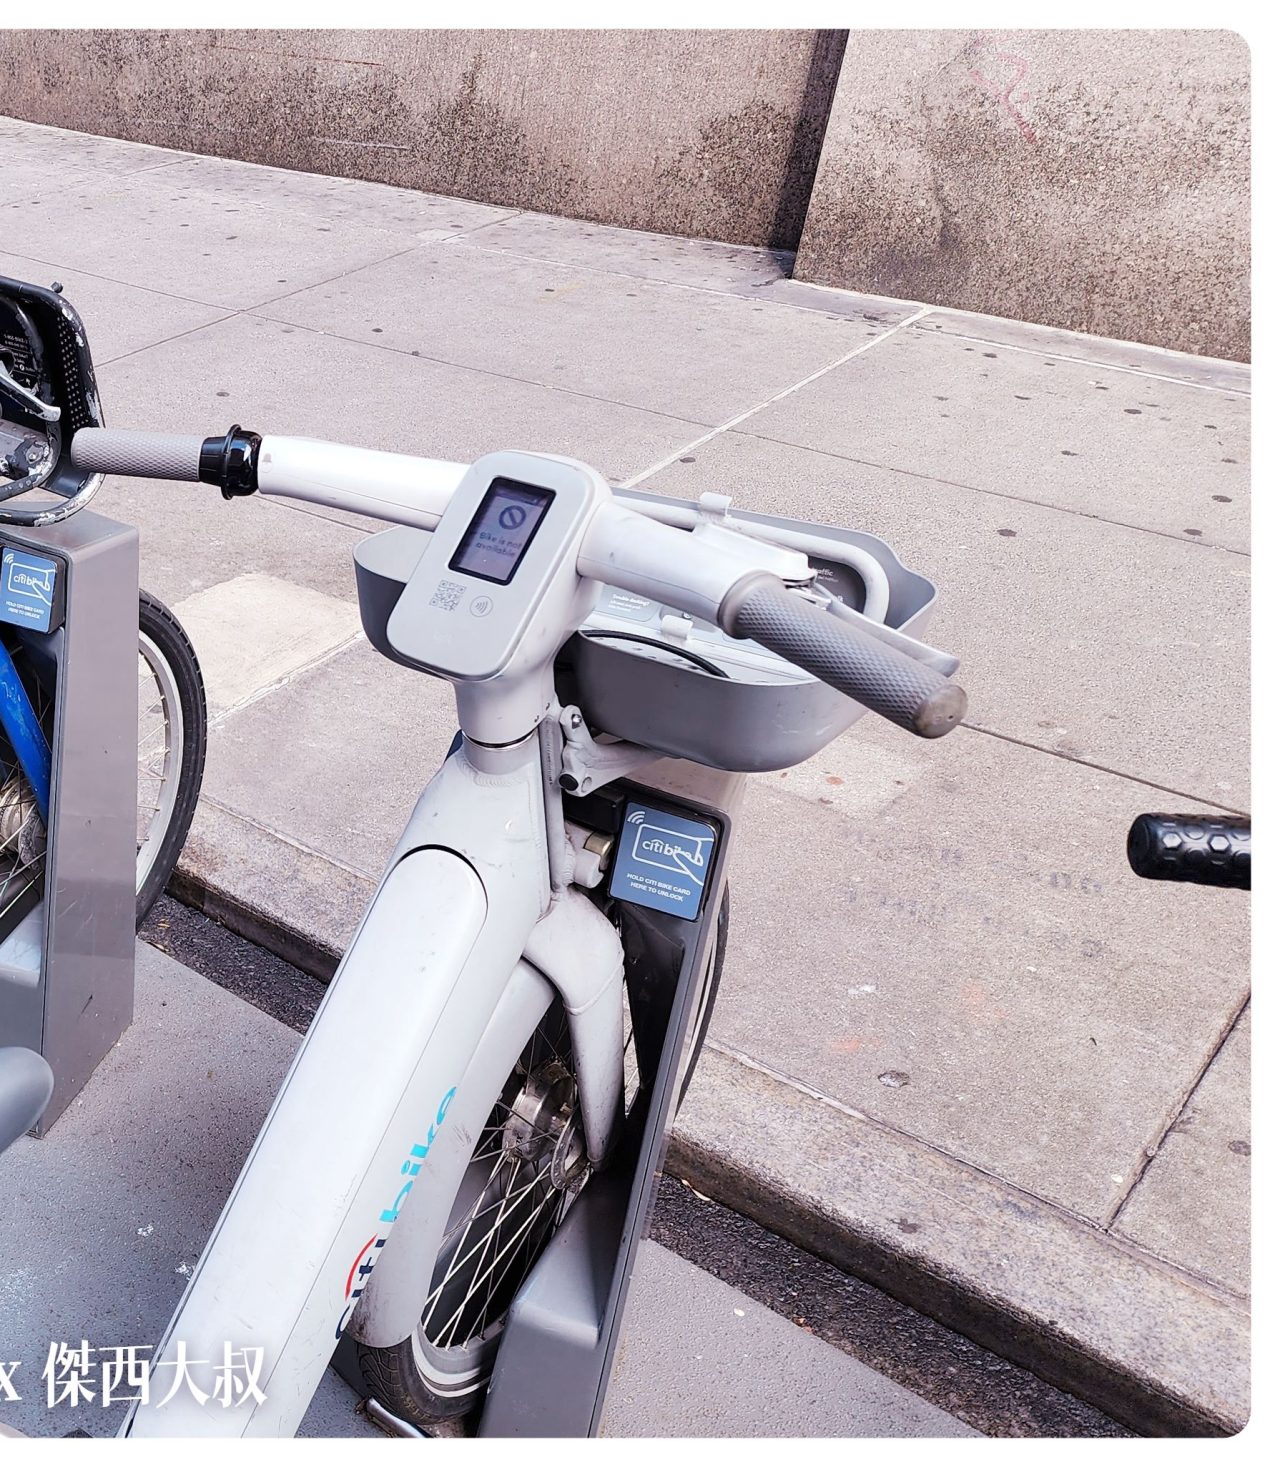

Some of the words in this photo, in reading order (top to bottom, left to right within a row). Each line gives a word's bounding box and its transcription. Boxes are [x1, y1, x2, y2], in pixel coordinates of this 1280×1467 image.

[626, 872, 644, 882] HOLD
[644, 877, 658, 886] CITI
[657, 881, 673, 891] BIKE
[672, 886, 691, 896] CARD
[630, 881, 647, 891] HERE
[657, 889, 684, 902] UNLOCK
